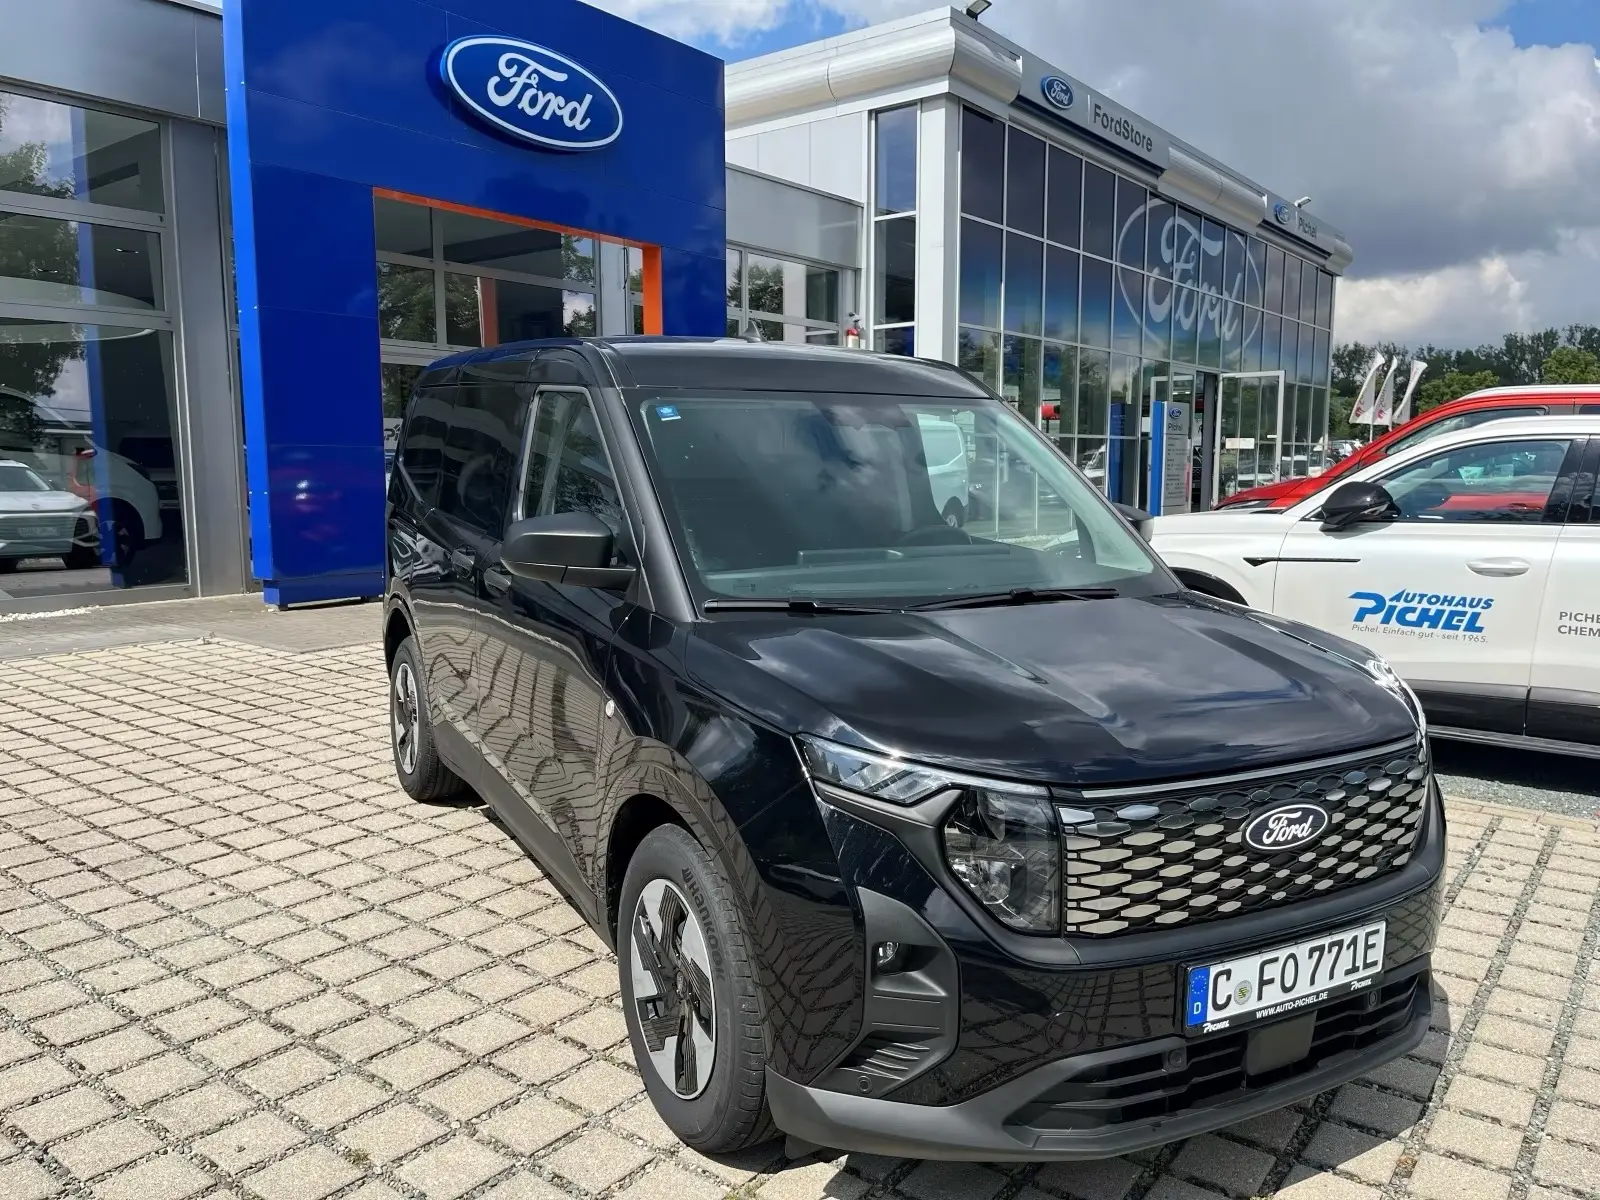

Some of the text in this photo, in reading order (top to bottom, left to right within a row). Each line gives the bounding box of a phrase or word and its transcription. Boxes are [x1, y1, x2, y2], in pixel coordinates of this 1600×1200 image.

[487, 52, 592, 131] Ford
[1050, 80, 1070, 105] Ford
[1093, 103, 1153, 152] FordStore
[1148, 216, 1243, 341] Ford
[1348, 591, 1485, 633] PICHEL
[1389, 588, 1494, 610] AUTOHAUS
[1382, 626, 1416, 637] Einfach
[1418, 631, 1434, 639] gut
[1441, 633, 1459, 641] seit
[1461, 634, 1489, 644] 1965.
[1262, 811, 1314, 844] Ford
[688, 880, 726, 982] Hankook
[1211, 967, 1232, 1012] C
[1256, 952, 1299, 1002] FO
[1308, 928, 1380, 987] 771E
[1194, 1002, 1201, 1014] D
[1256, 991, 1329, 1019] WWW.AUTO-PICHEL.DE
